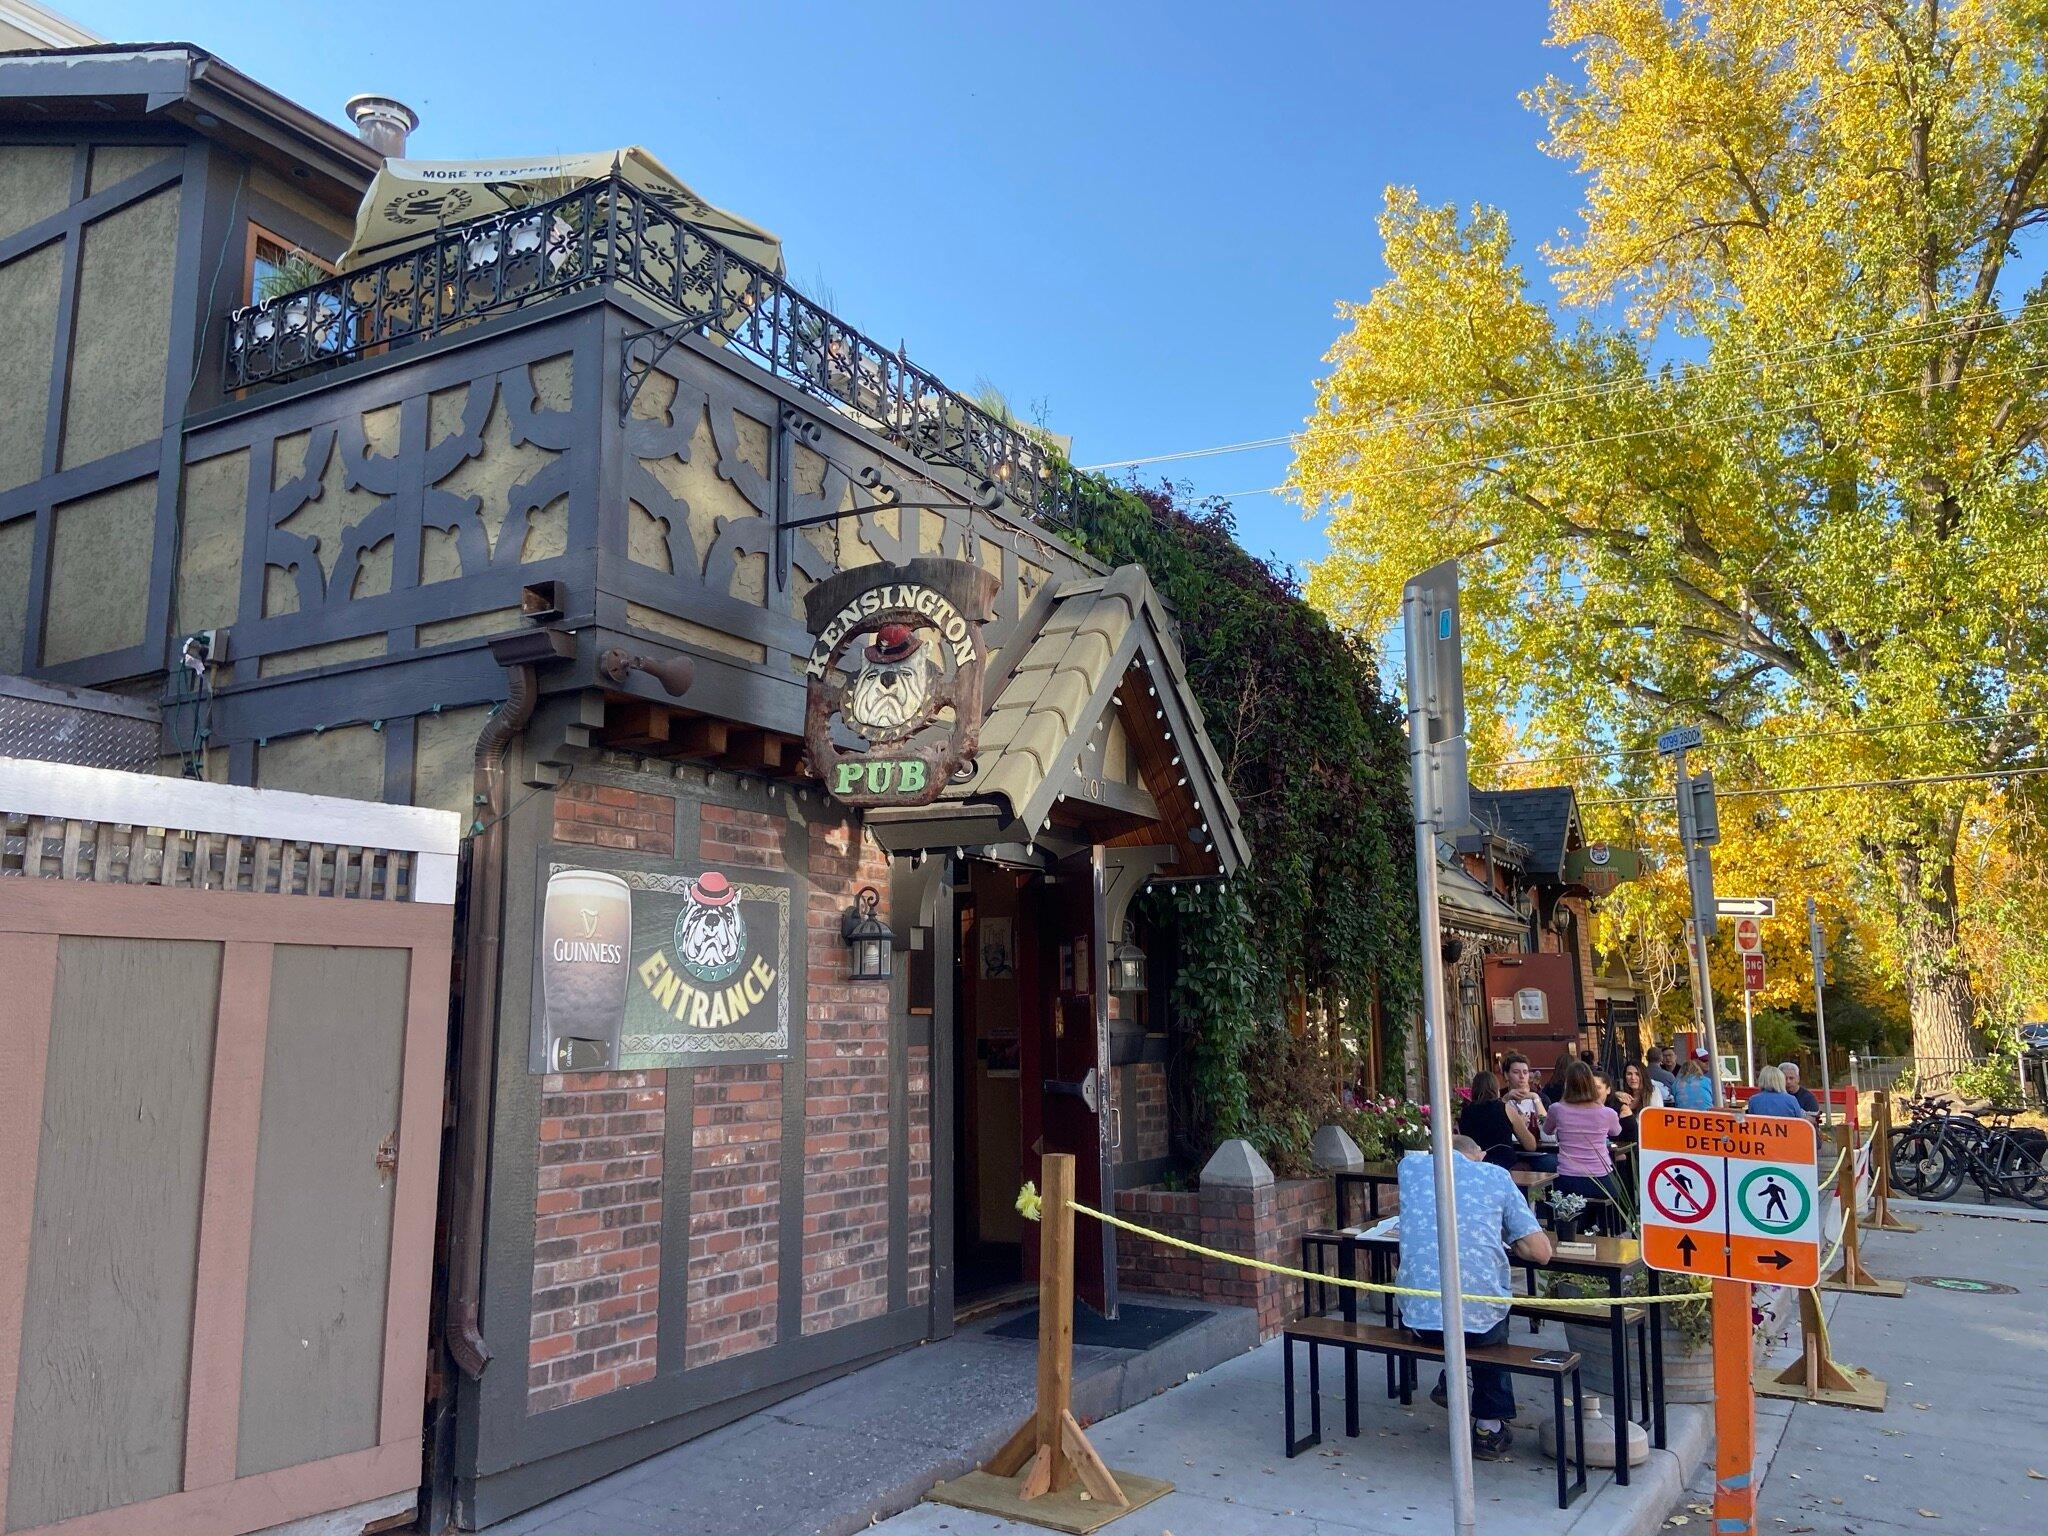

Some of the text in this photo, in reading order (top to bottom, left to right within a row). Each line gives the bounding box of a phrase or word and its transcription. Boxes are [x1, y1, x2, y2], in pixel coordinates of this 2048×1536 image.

[422, 169, 468, 180] MORE
[474, 170, 493, 179] TO
[805, 583, 977, 680] KENSINGTON
[1661, 729, 1697, 750] 2799 2800
[834, 761, 927, 795] PUB
[1082, 776, 1107, 802] 207
[553, 938, 621, 965] GUINNESS
[1745, 960, 1762, 970] ONG
[637, 948, 778, 1029] ENTRANCE
[1745, 974, 1757, 985] AY
[1664, 1114, 1789, 1138] PEDESTRIAN
[1686, 1135, 1766, 1156] DETOUR
